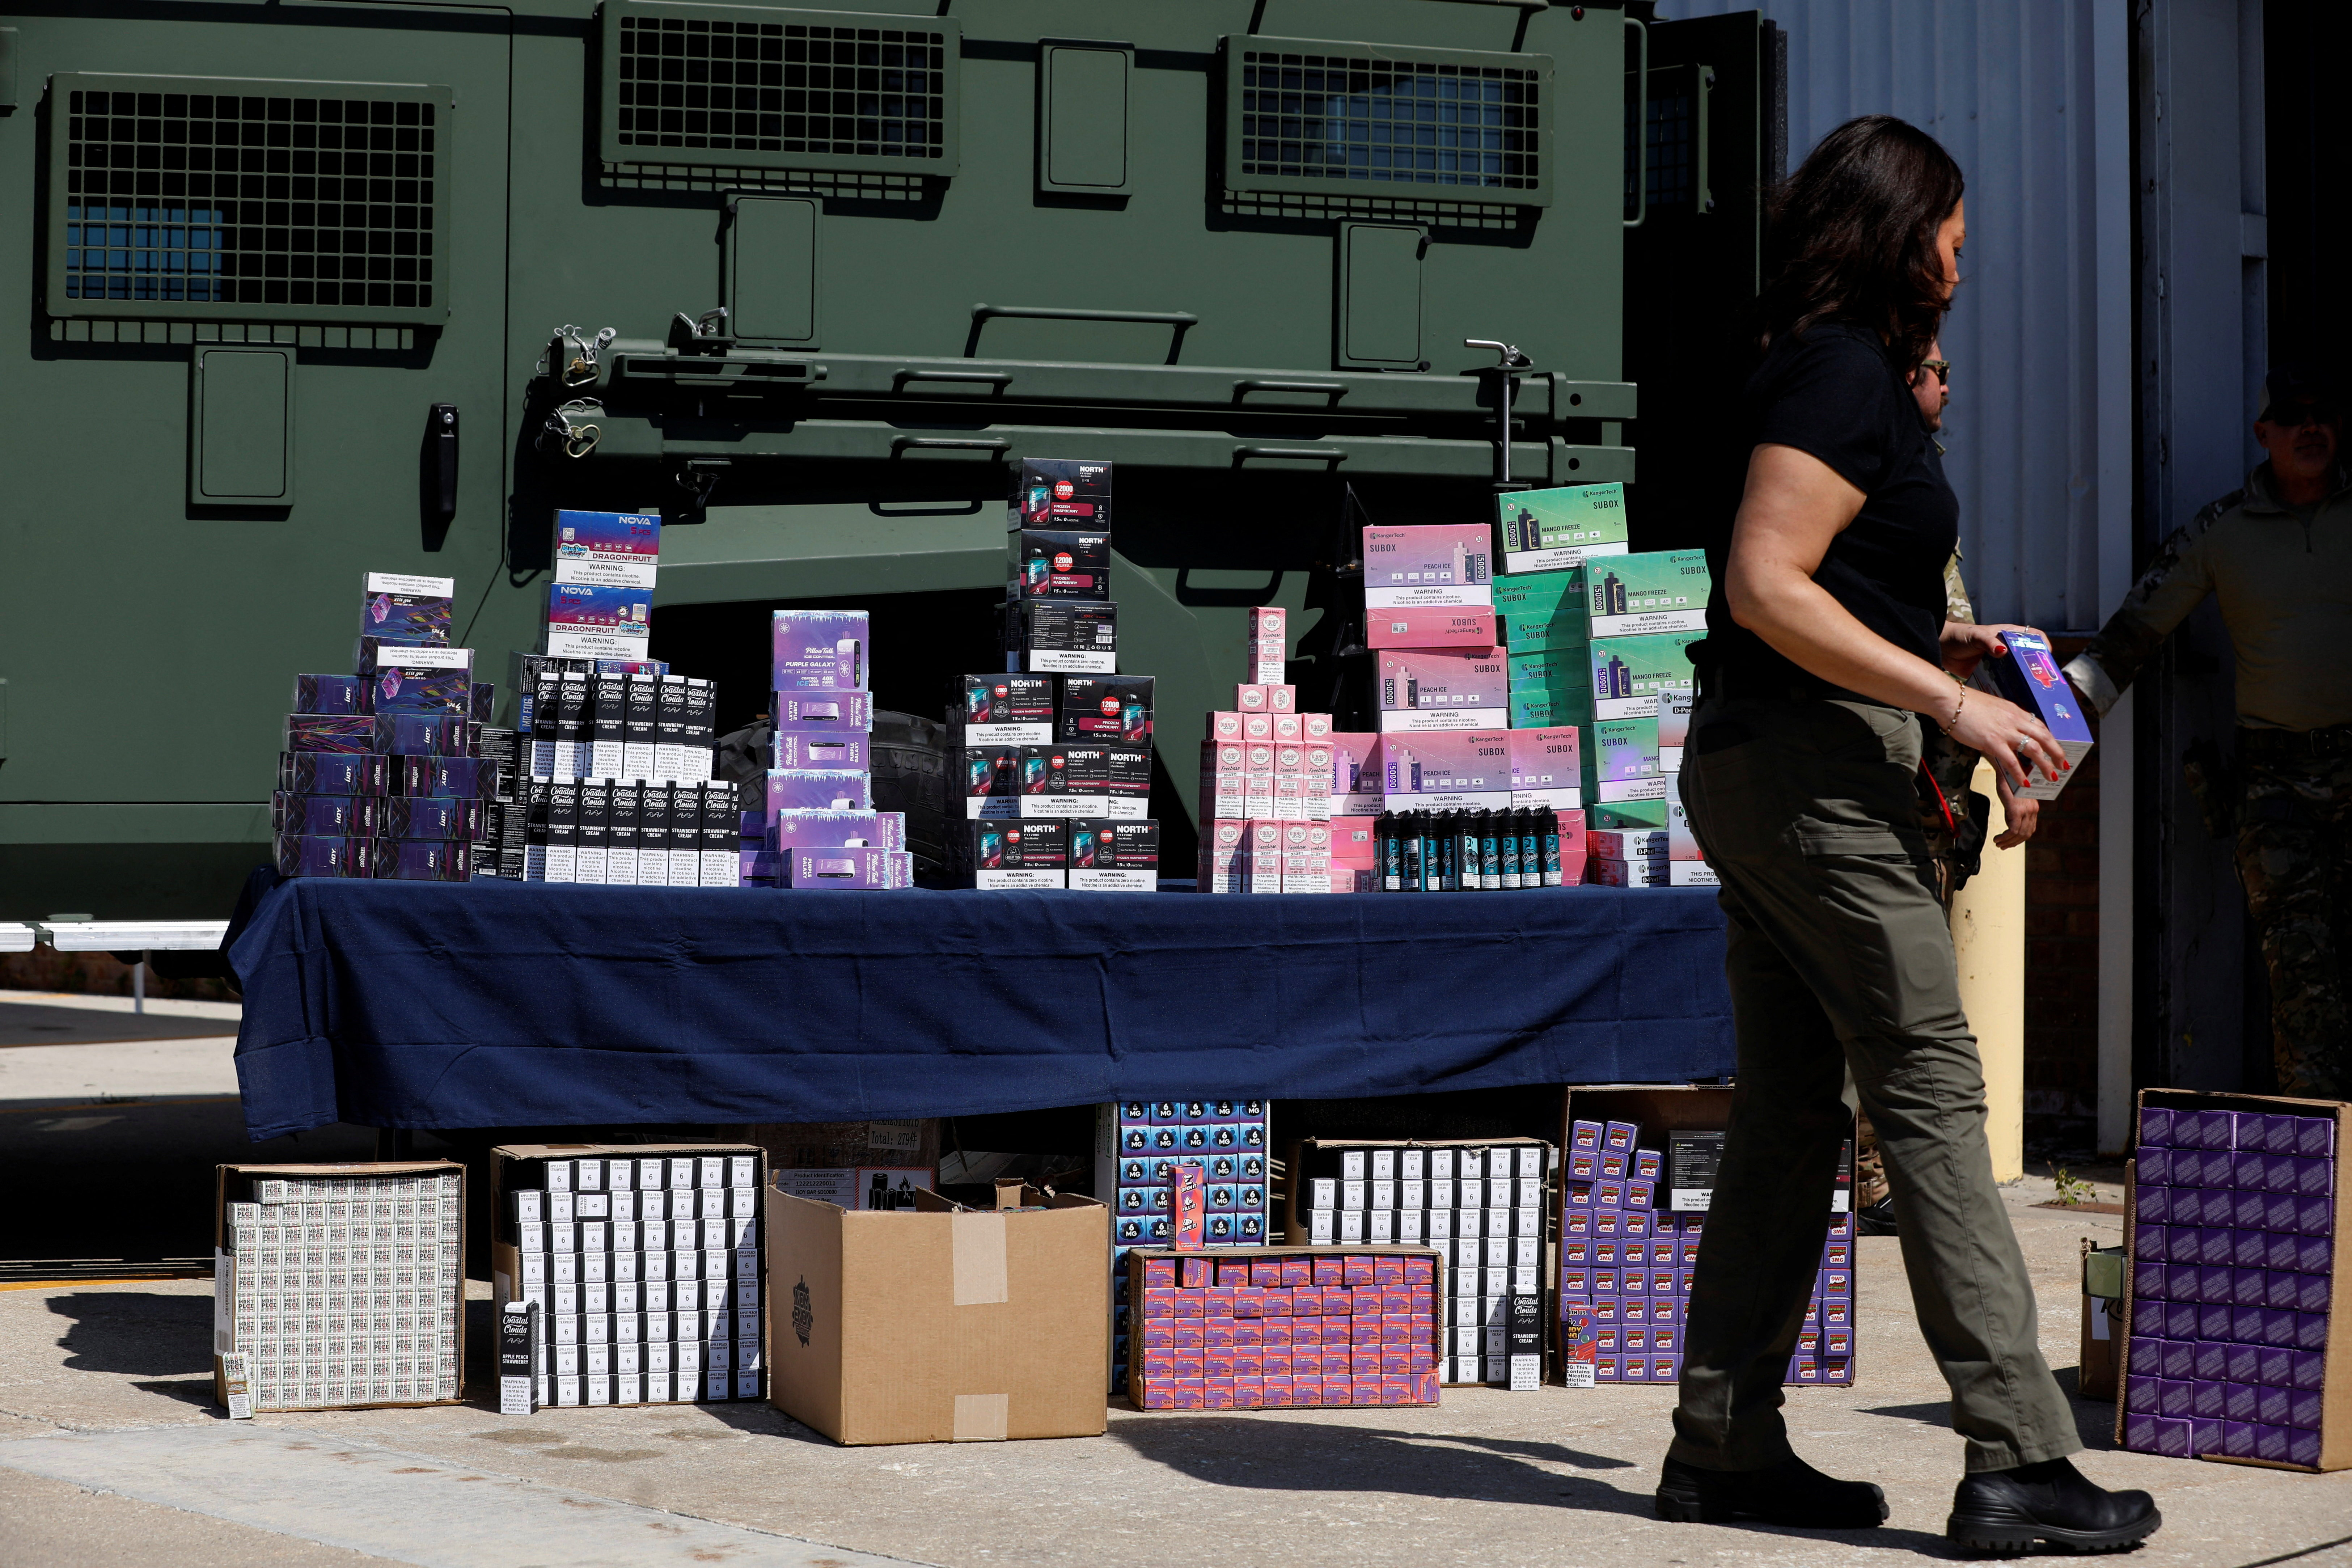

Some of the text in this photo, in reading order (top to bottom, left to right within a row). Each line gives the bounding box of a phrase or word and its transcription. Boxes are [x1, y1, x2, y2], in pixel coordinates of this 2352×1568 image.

[1593, 500, 1619, 509] SUBOX
[619, 516, 651, 525] NOVA
[593, 553, 652, 562] DRAGONFRUIT
[1680, 566, 1706, 575] SUBOX
[561, 587, 593, 595] NOVA
[1502, 593, 1526, 602] SUBOX
[556, 625, 615, 634] DRAGONFRUIT
[598, 681, 623, 692] Coastal
[599, 691, 622, 700] Clouds
[522, 699, 533, 727] MR FOG
[1602, 737, 1628, 747] SUBOX
[551, 786, 576, 796] Coastal
[551, 796, 574, 805] Clouds
[871, 1131, 893, 1145] Total:
[1514, 1297, 1538, 1306] Coastal
[1515, 1305, 1537, 1315] Clouds
[503, 1315, 528, 1326] Coastal
[504, 1324, 527, 1334] Clouds
